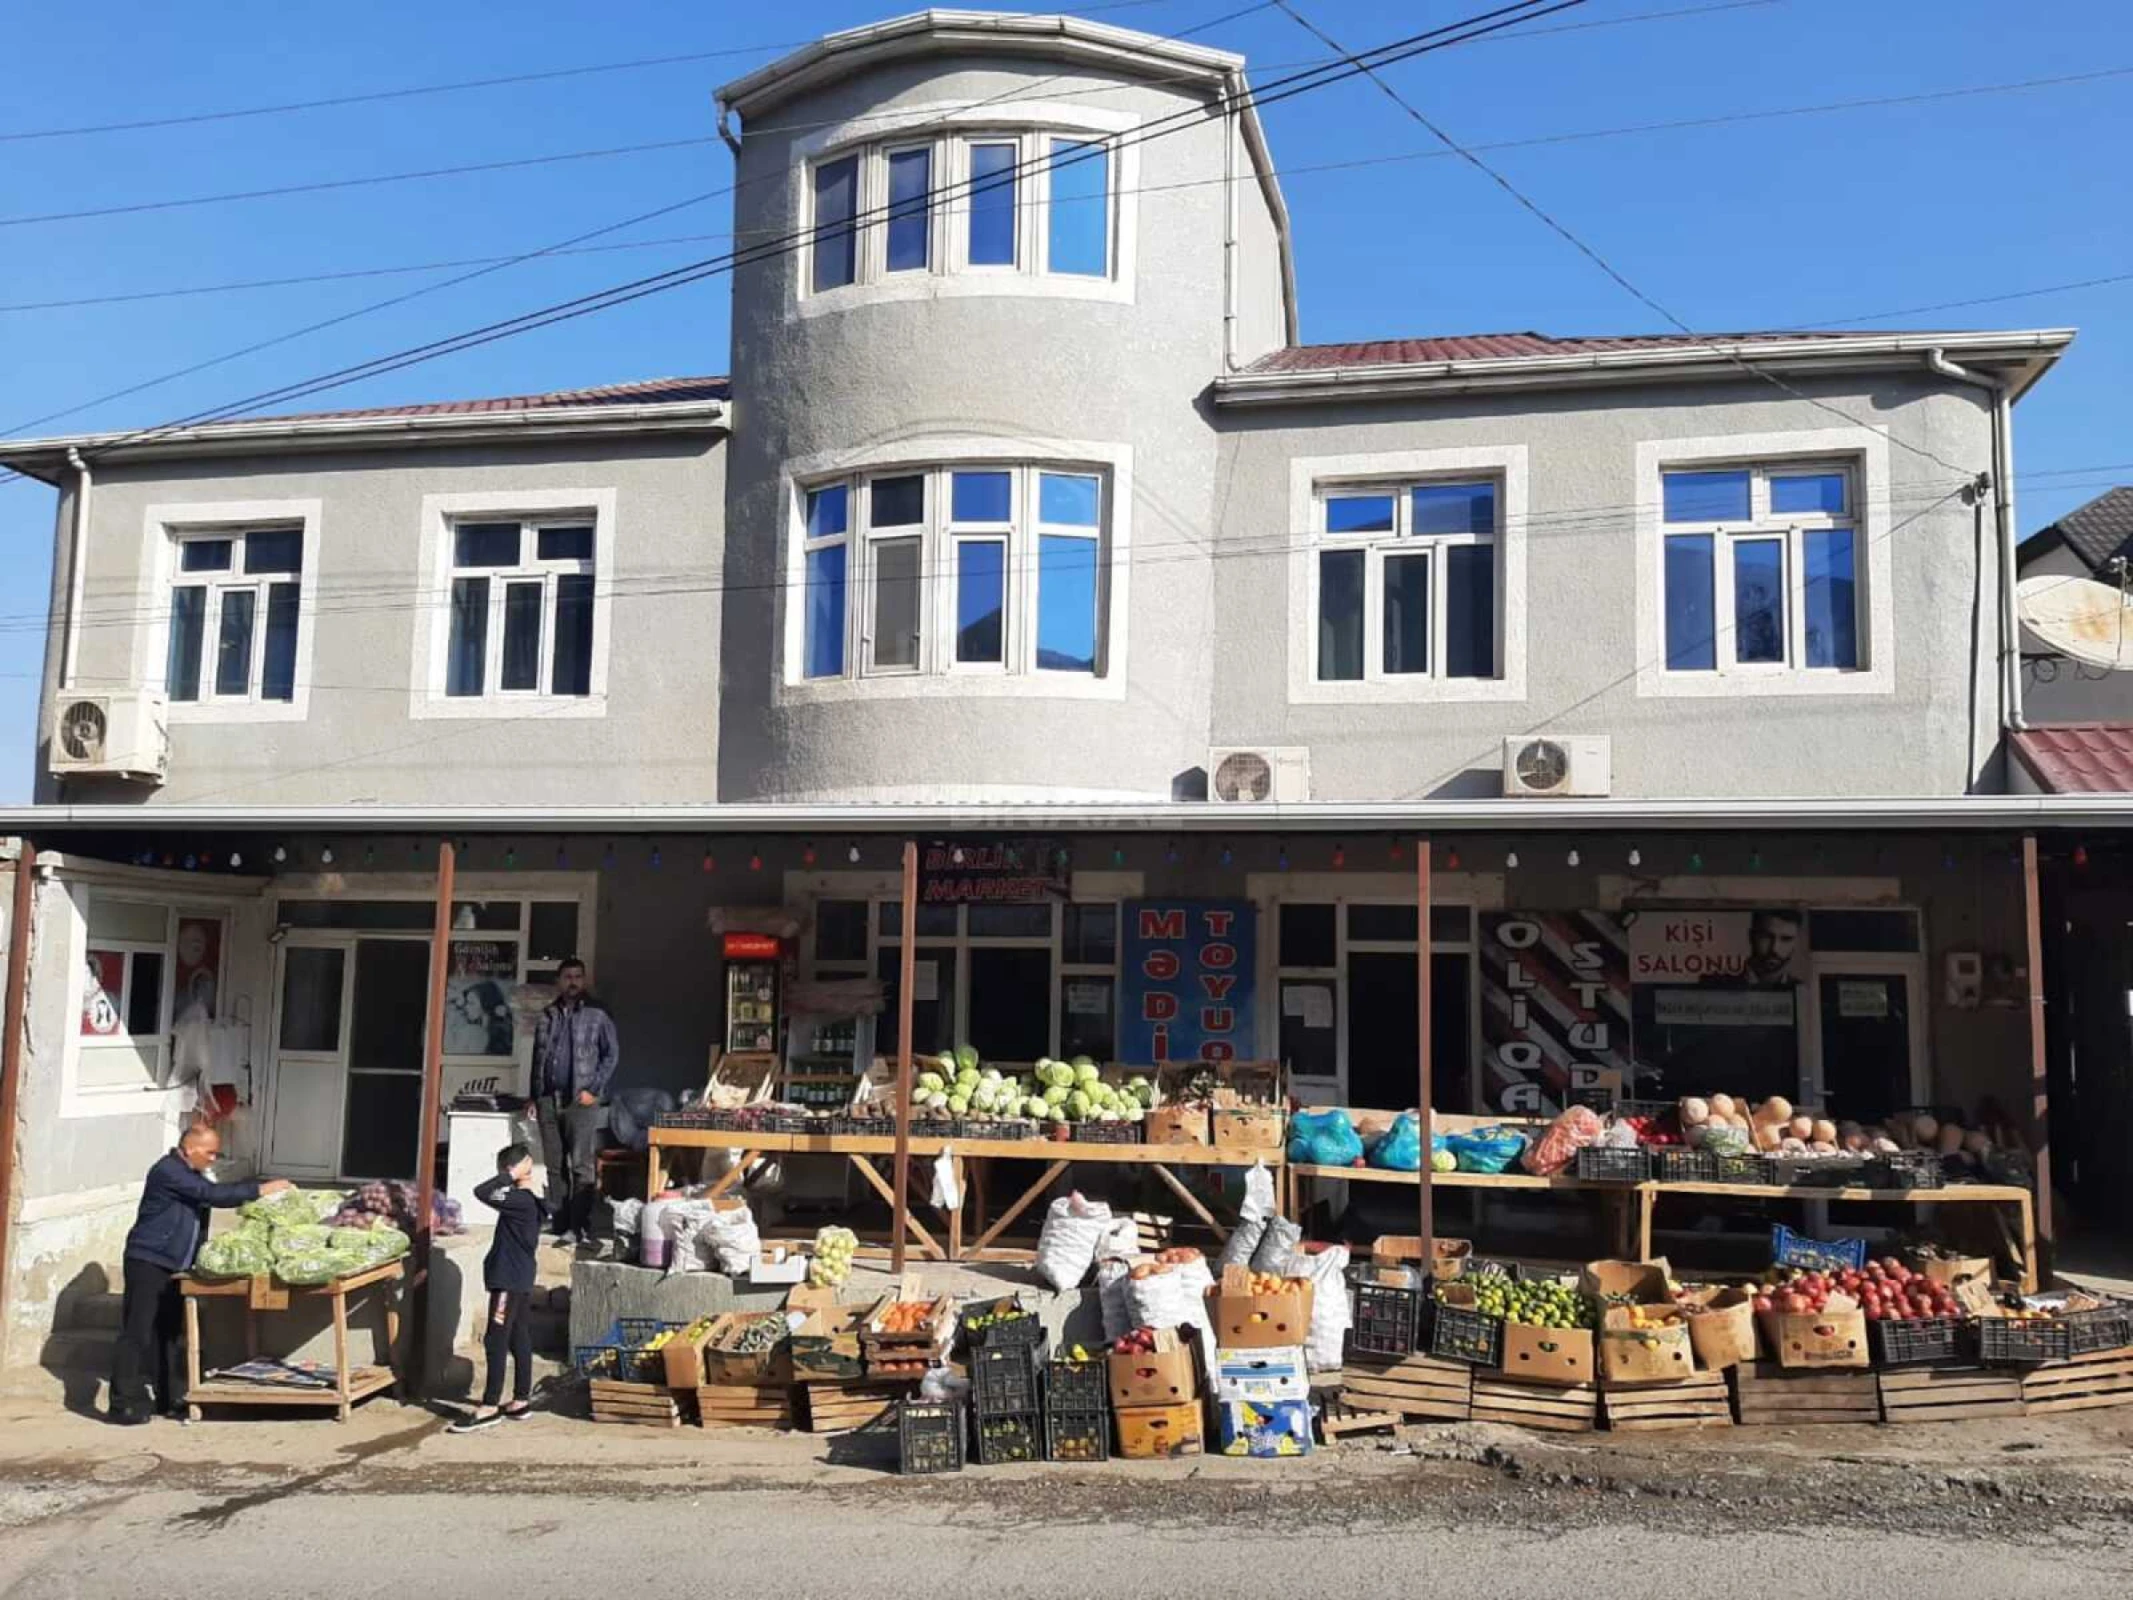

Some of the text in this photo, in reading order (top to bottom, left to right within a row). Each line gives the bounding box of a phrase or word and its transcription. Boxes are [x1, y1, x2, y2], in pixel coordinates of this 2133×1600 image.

[923, 878, 1047, 900] MARKET
[1665, 919, 1714, 948] KİŞİ
[1637, 954, 1743, 974] SALONU
